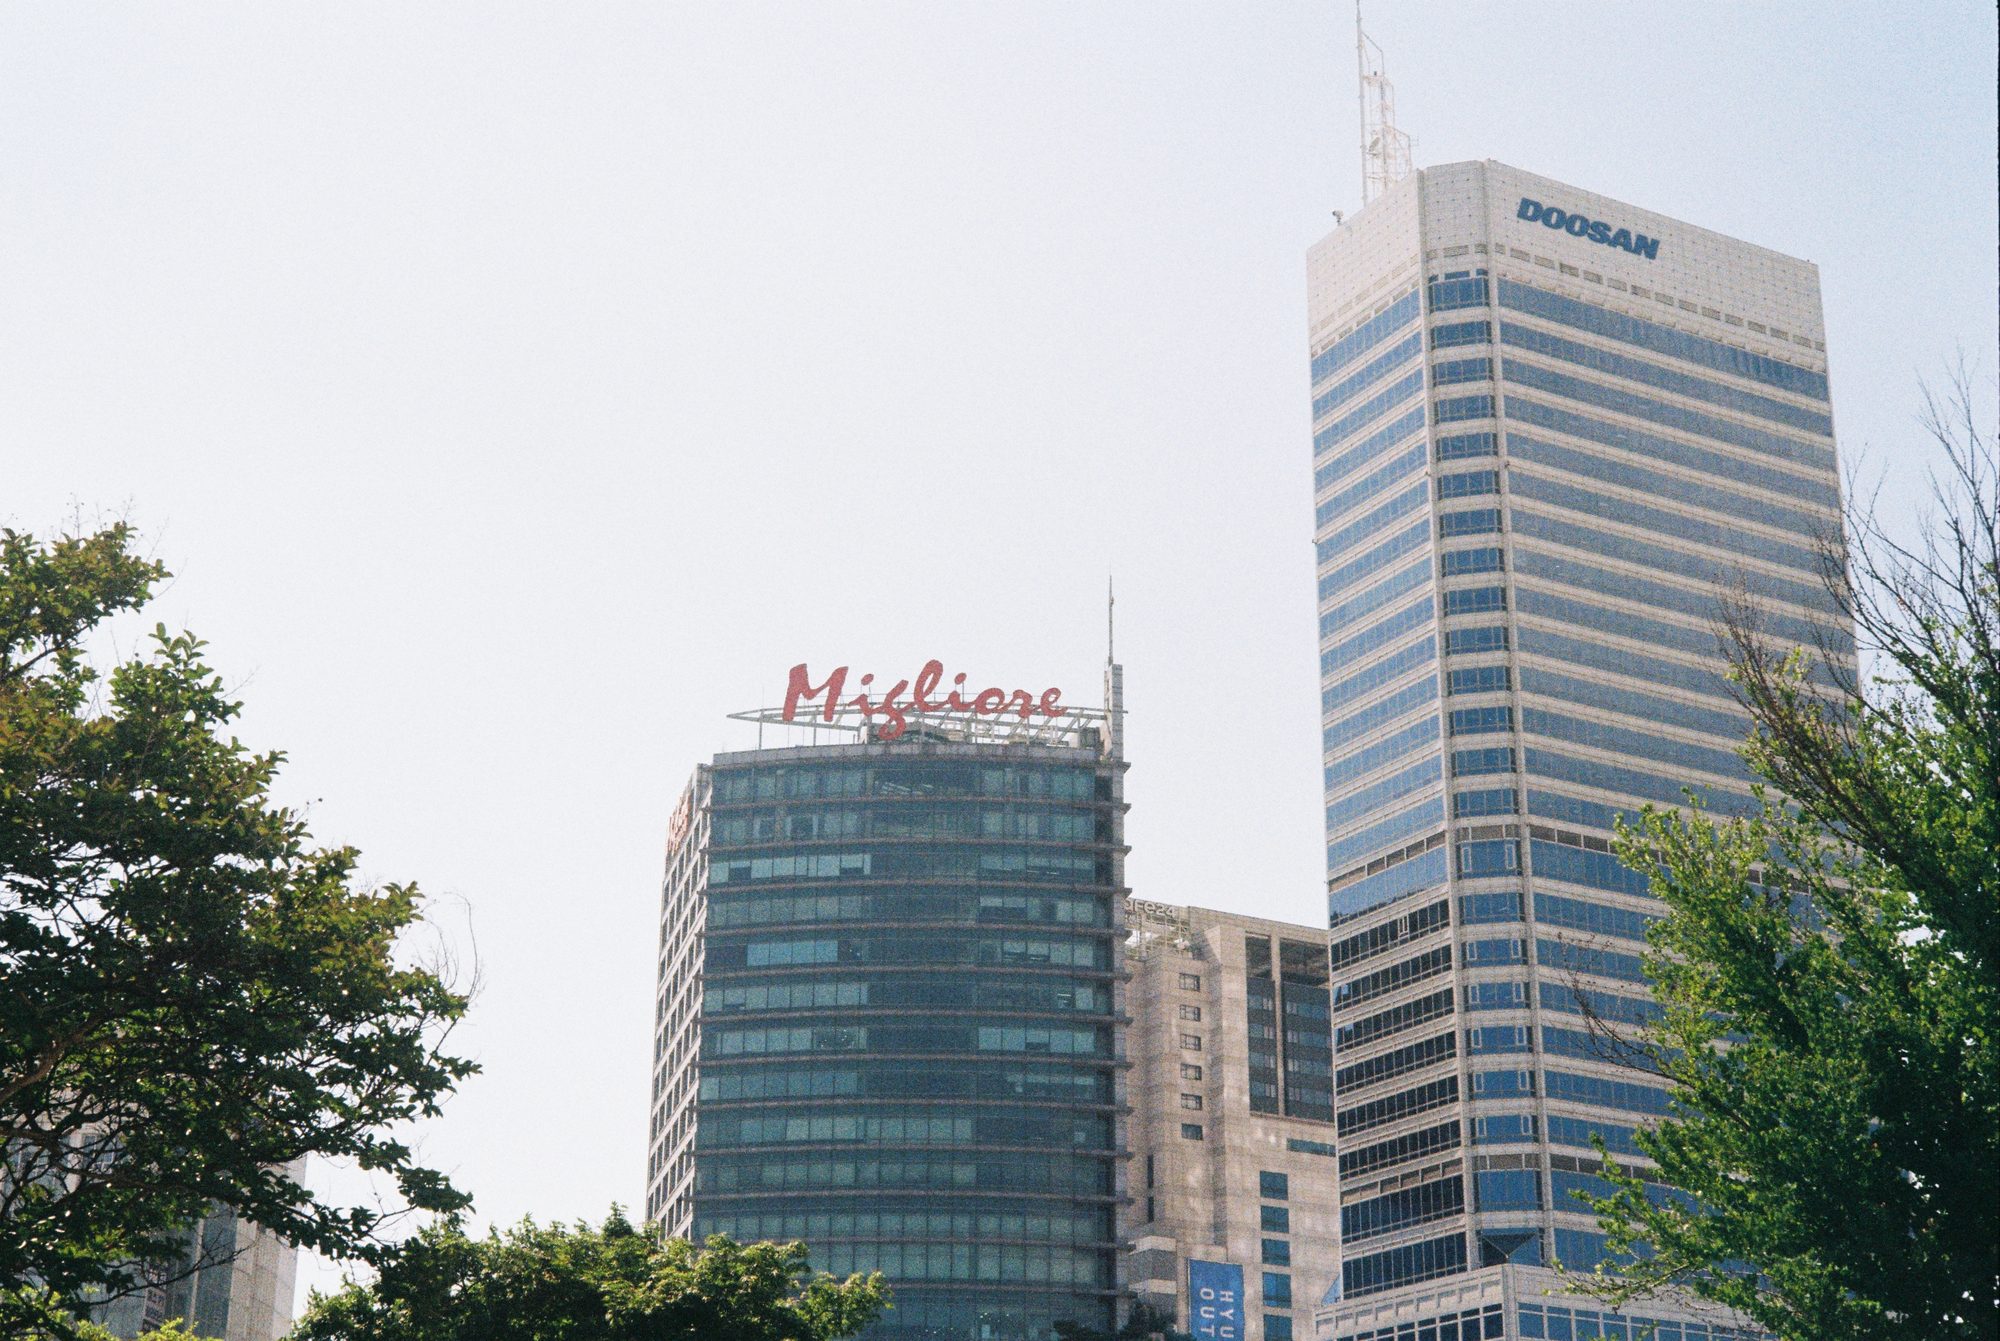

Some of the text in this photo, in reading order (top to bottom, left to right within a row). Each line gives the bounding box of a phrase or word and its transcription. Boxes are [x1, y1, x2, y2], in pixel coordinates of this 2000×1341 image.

[1517, 197, 1660, 260] DOOSAN
[782, 659, 1067, 740] Migliore
[1200, 1287, 1215, 1337] OUT
[1219, 1290, 1234, 1338] HYU
